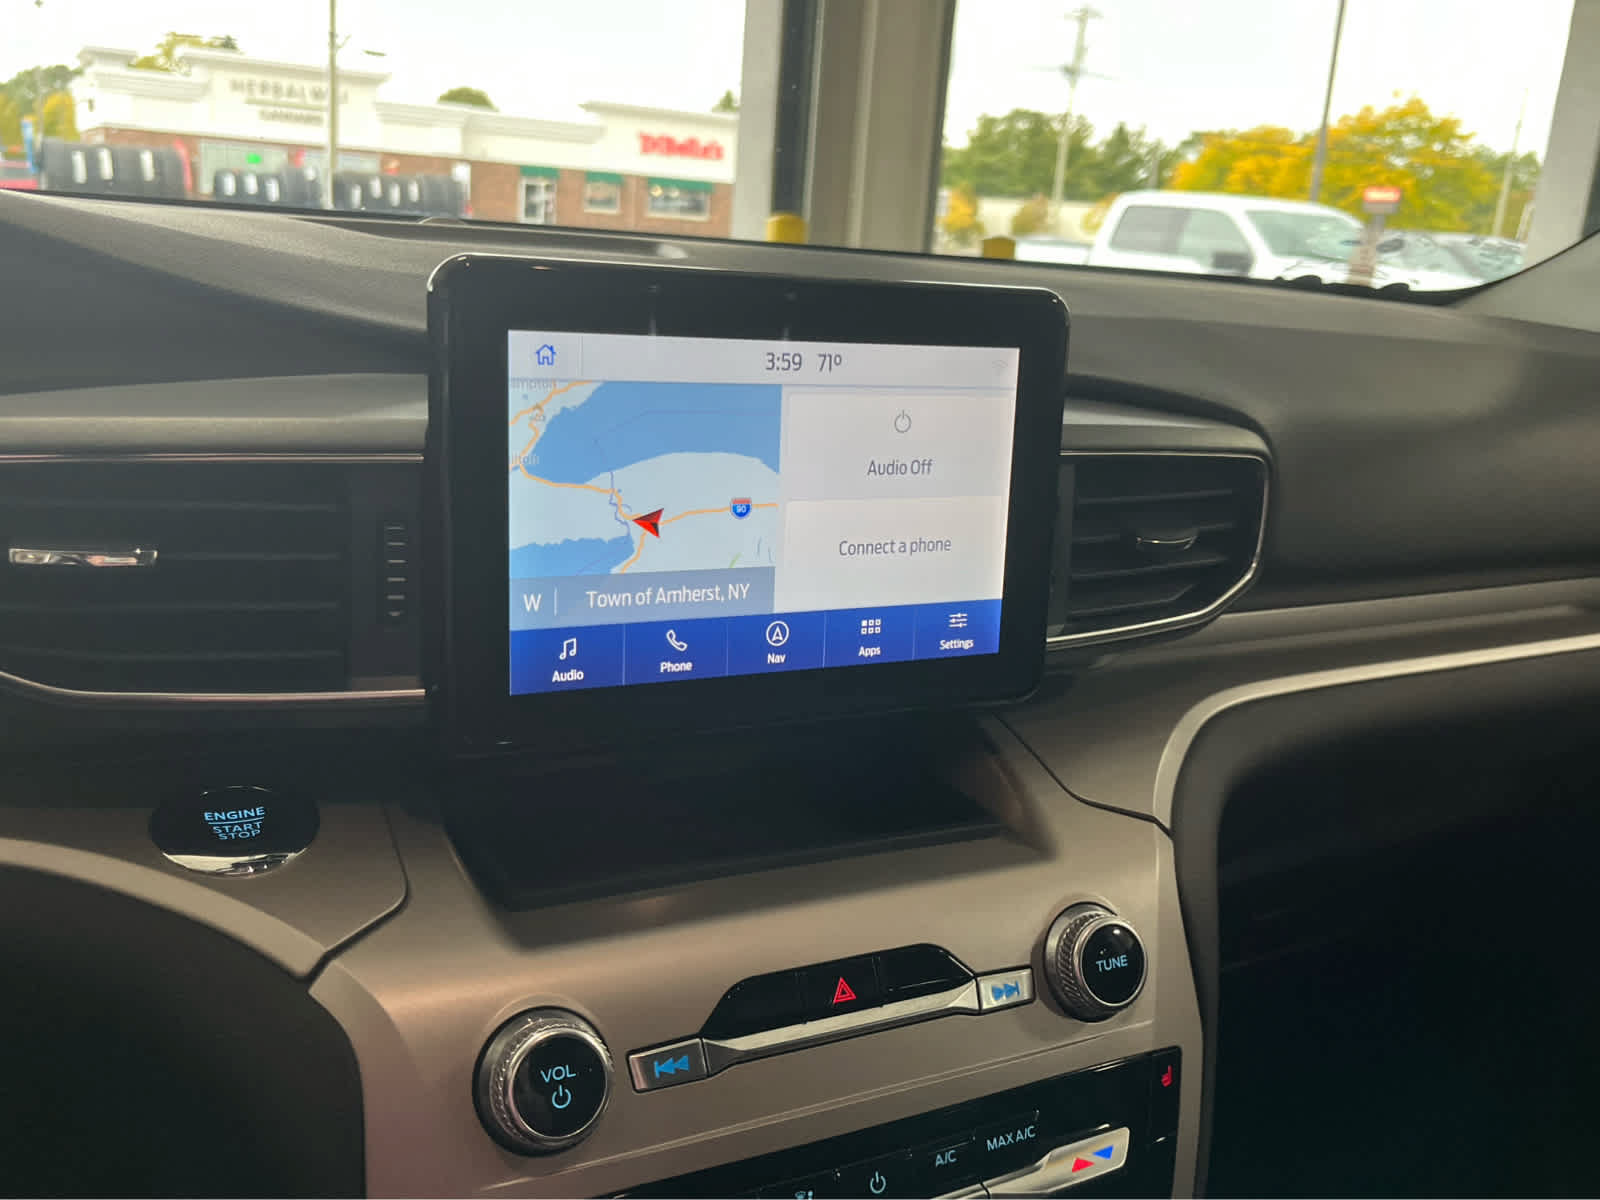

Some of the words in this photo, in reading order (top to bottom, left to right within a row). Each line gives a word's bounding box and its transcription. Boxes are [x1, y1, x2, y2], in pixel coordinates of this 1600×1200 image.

[765, 352, 802, 371] 3:59
[867, 459, 908, 476] Audio
[910, 459, 933, 475] Off
[839, 538, 896, 556] Connect
[898, 542, 907, 553] a
[909, 537, 952, 555] phone
[523, 593, 542, 612] W
[586, 590, 633, 609] Town
[635, 588, 652, 606] of
[655, 586, 725, 604] Amherst,
[727, 583, 750, 600] NY
[858, 645, 881, 657] Apps
[939, 637, 974, 650] Settings
[660, 660, 693, 673] Phone
[767, 652, 786, 664] Nav
[552, 669, 584, 683] Audio
[204, 806, 266, 821] ENGINE
[213, 821, 262, 834] START
[218, 829, 261, 840] STOP
[1095, 954, 1129, 972] TUNE
[540, 1065, 576, 1083] VOL
[986, 1134, 1014, 1152] MAX
[1015, 1125, 1036, 1142] A/C
[935, 1150, 957, 1167] A/C
